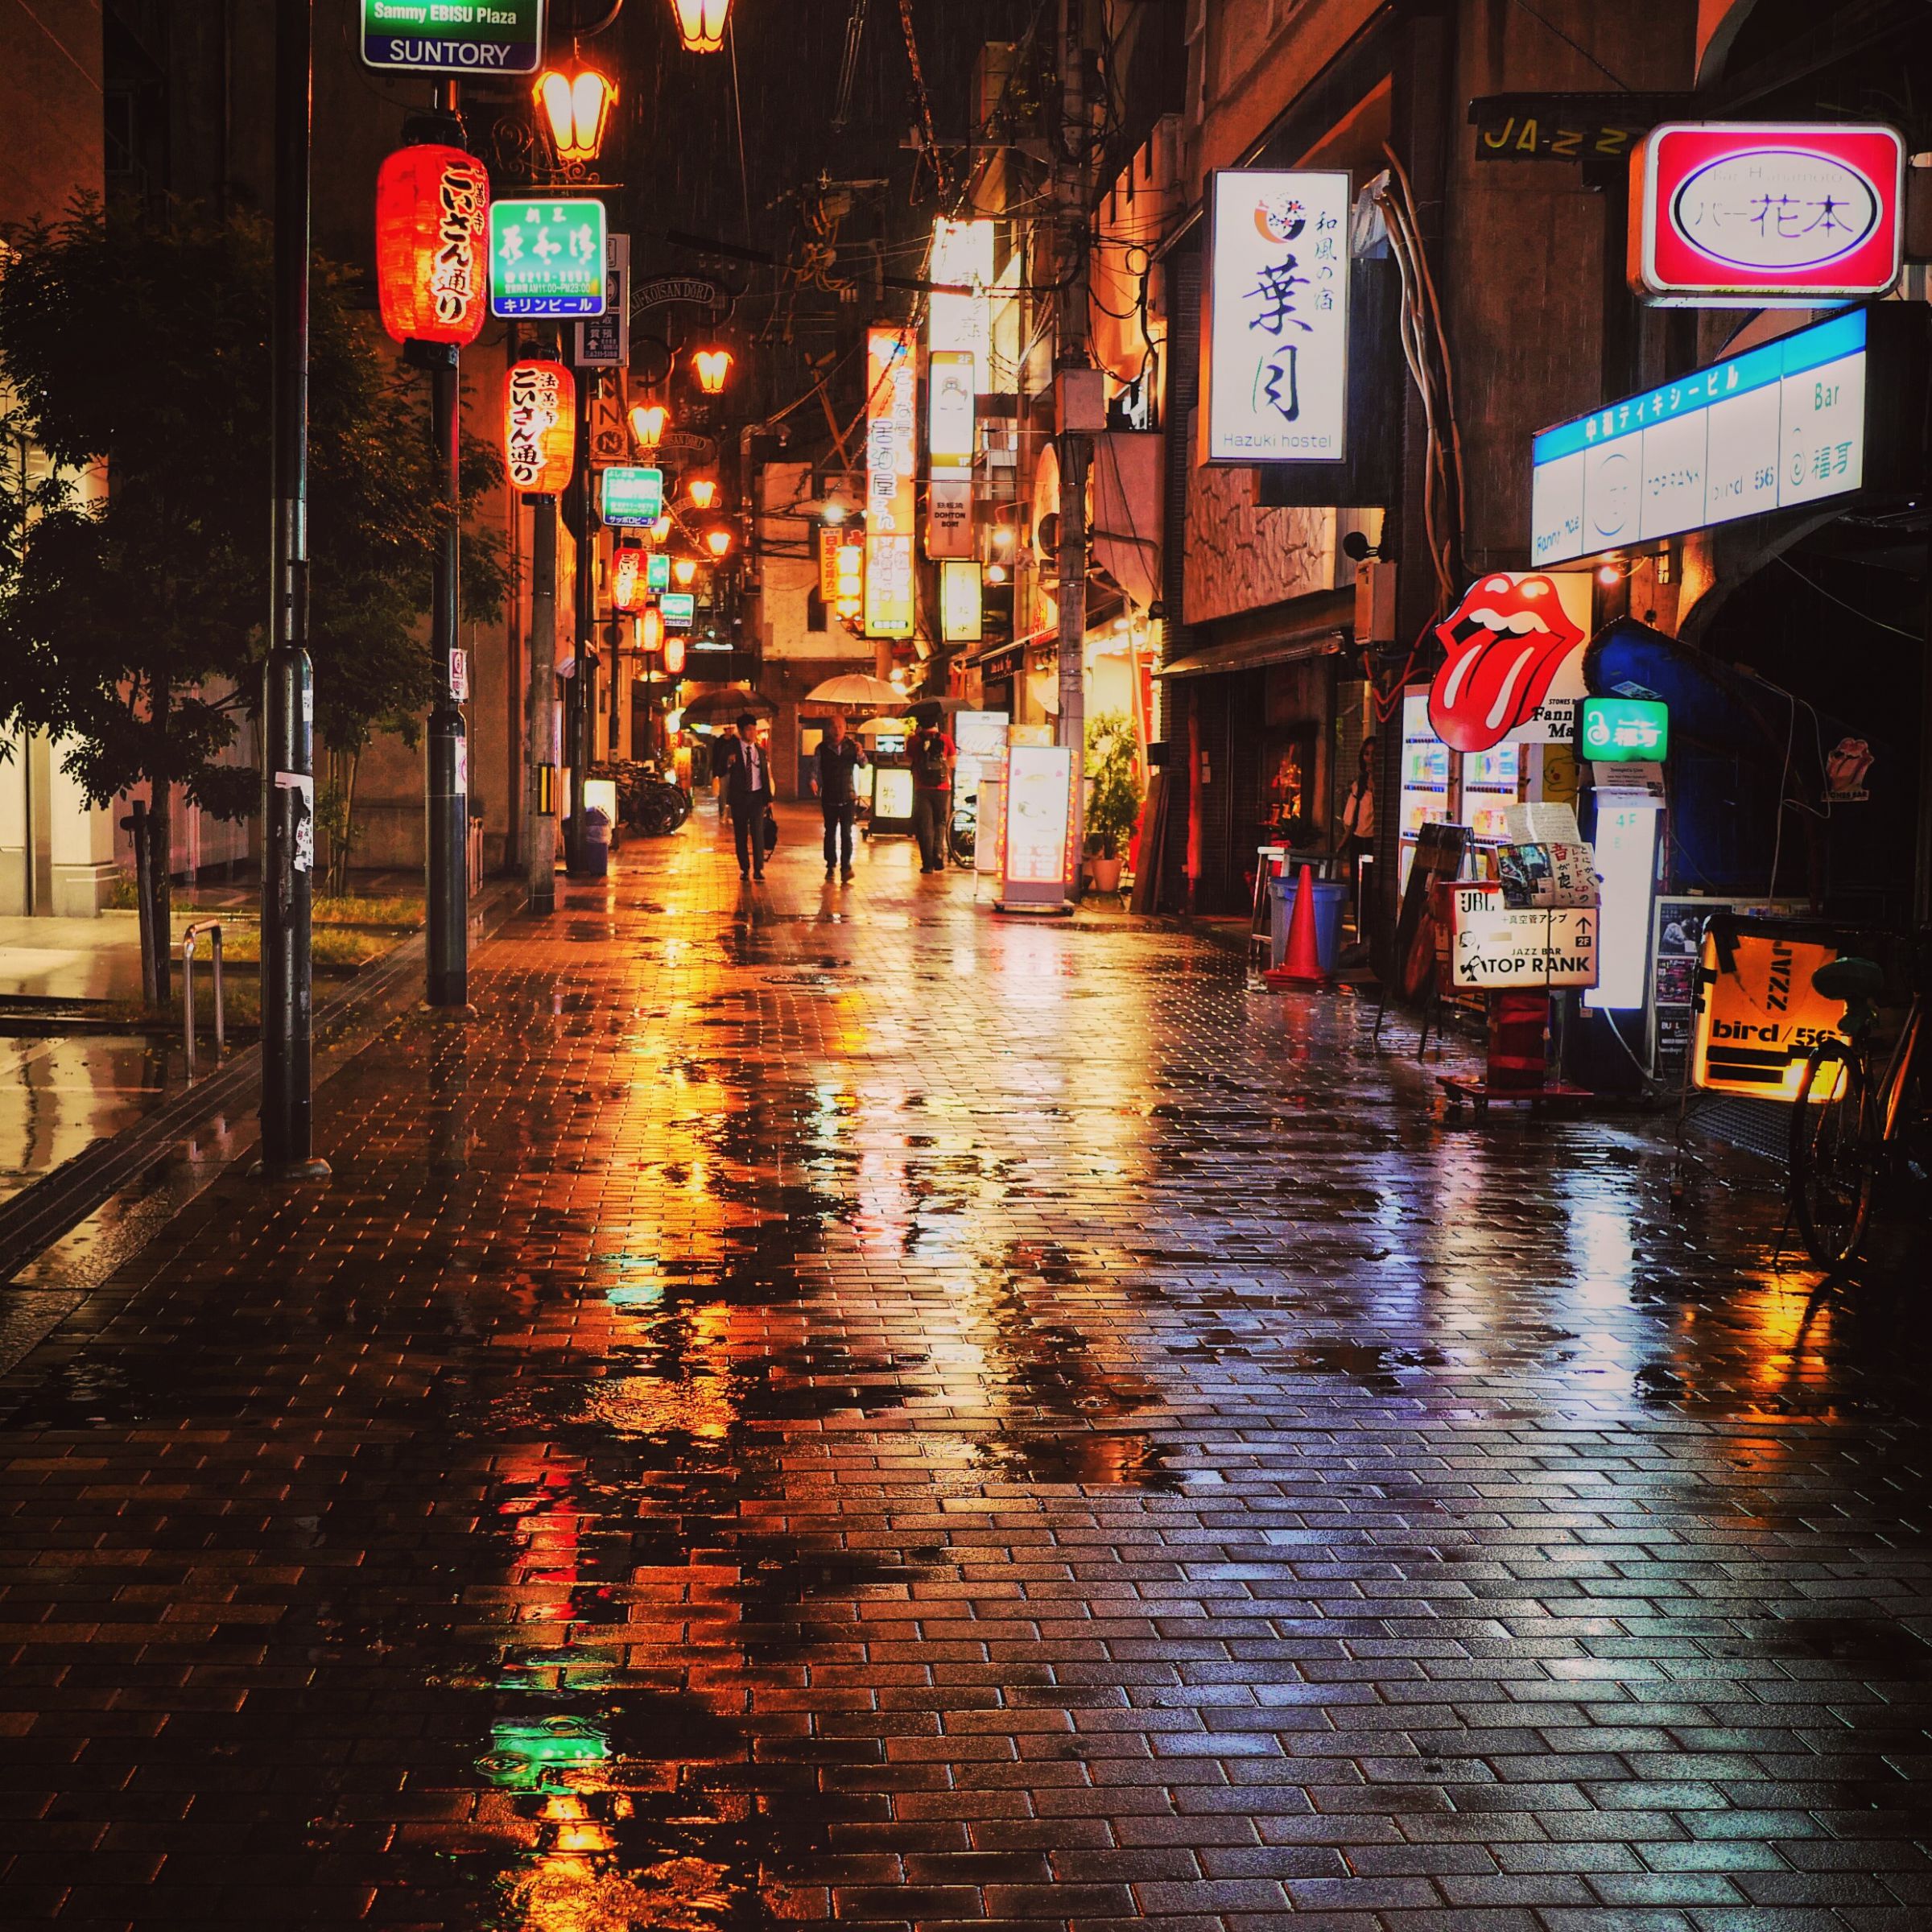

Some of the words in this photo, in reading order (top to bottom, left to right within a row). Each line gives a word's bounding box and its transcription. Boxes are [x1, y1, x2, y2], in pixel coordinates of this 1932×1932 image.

[374, 2, 426, 23] Sammy
[430, 4, 472, 23] EBISU
[477, 7, 517, 24] Plaza
[390, 39, 510, 65] SUNTORY
[1695, 193, 1854, 238] バー花本
[436, 160, 473, 321] こいさん通り
[1314, 211, 1338, 311] 和風の宿
[504, 298, 593, 313] キリンビール
[1241, 253, 1315, 423] 葉月
[957, 355, 972, 364] 2F
[1814, 382, 1839, 411] Bar
[510, 369, 540, 482] こいさん通り
[1224, 433, 1276, 448] Hazuki
[1282, 435, 1331, 448] hostel
[1531, 707, 1573, 721] Fann
[1548, 723, 1574, 738] Ma
[1461, 892, 1495, 913] JBL
[1512, 947, 1538, 956] JAZZ
[1541, 947, 1562, 956] BAR
[1576, 937, 1591, 947] 2F
[1488, 957, 1525, 973] TOP
[1532, 956, 1590, 972] RANK
